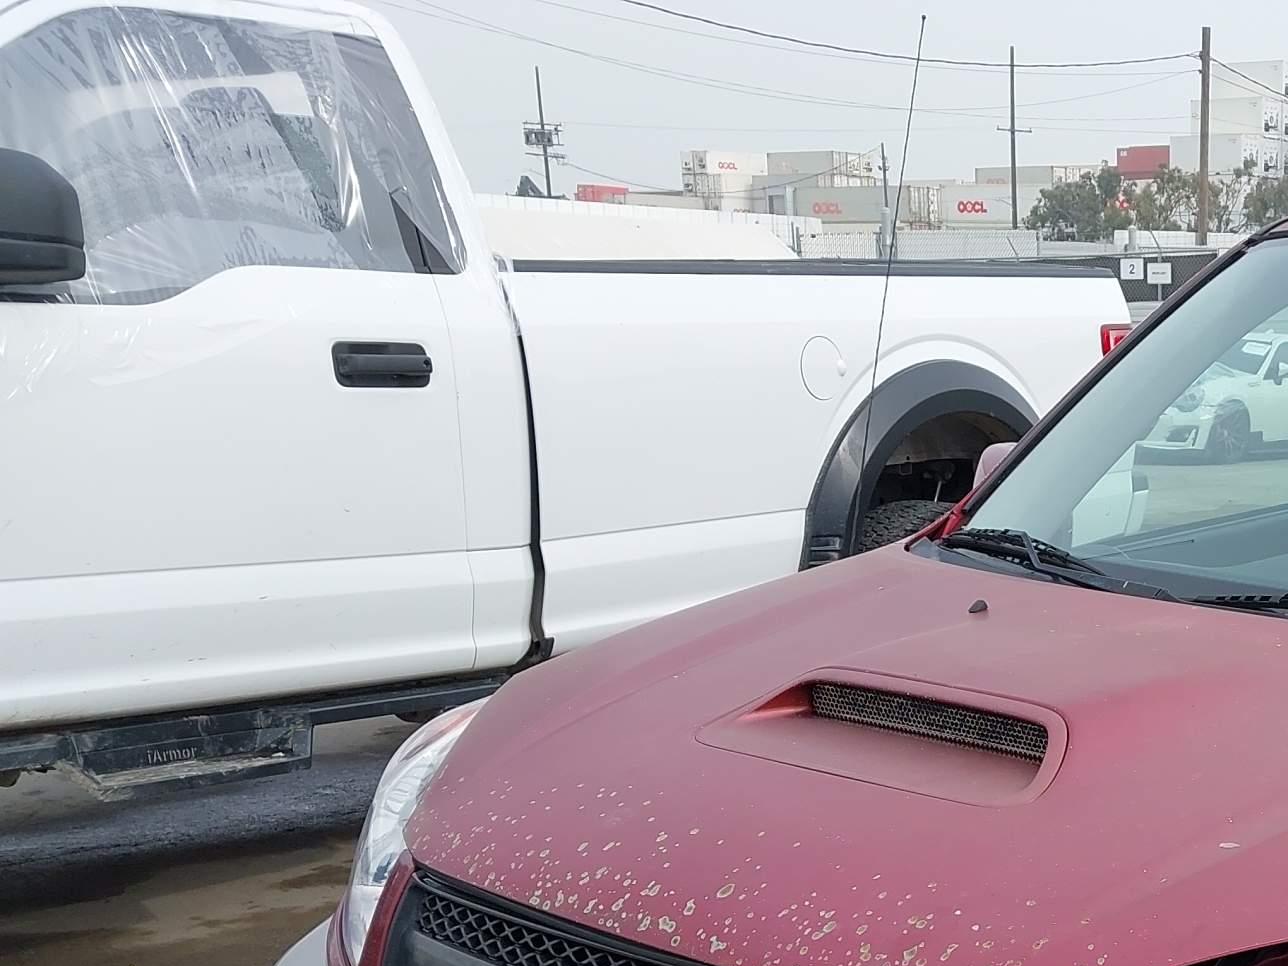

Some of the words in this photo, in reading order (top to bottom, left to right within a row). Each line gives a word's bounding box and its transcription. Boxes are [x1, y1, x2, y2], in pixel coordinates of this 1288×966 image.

[812, 202, 842, 215] OOCL
[957, 201, 987, 213] OOCL
[1128, 263, 1136, 275] 2
[147, 747, 197, 764] iArmor
